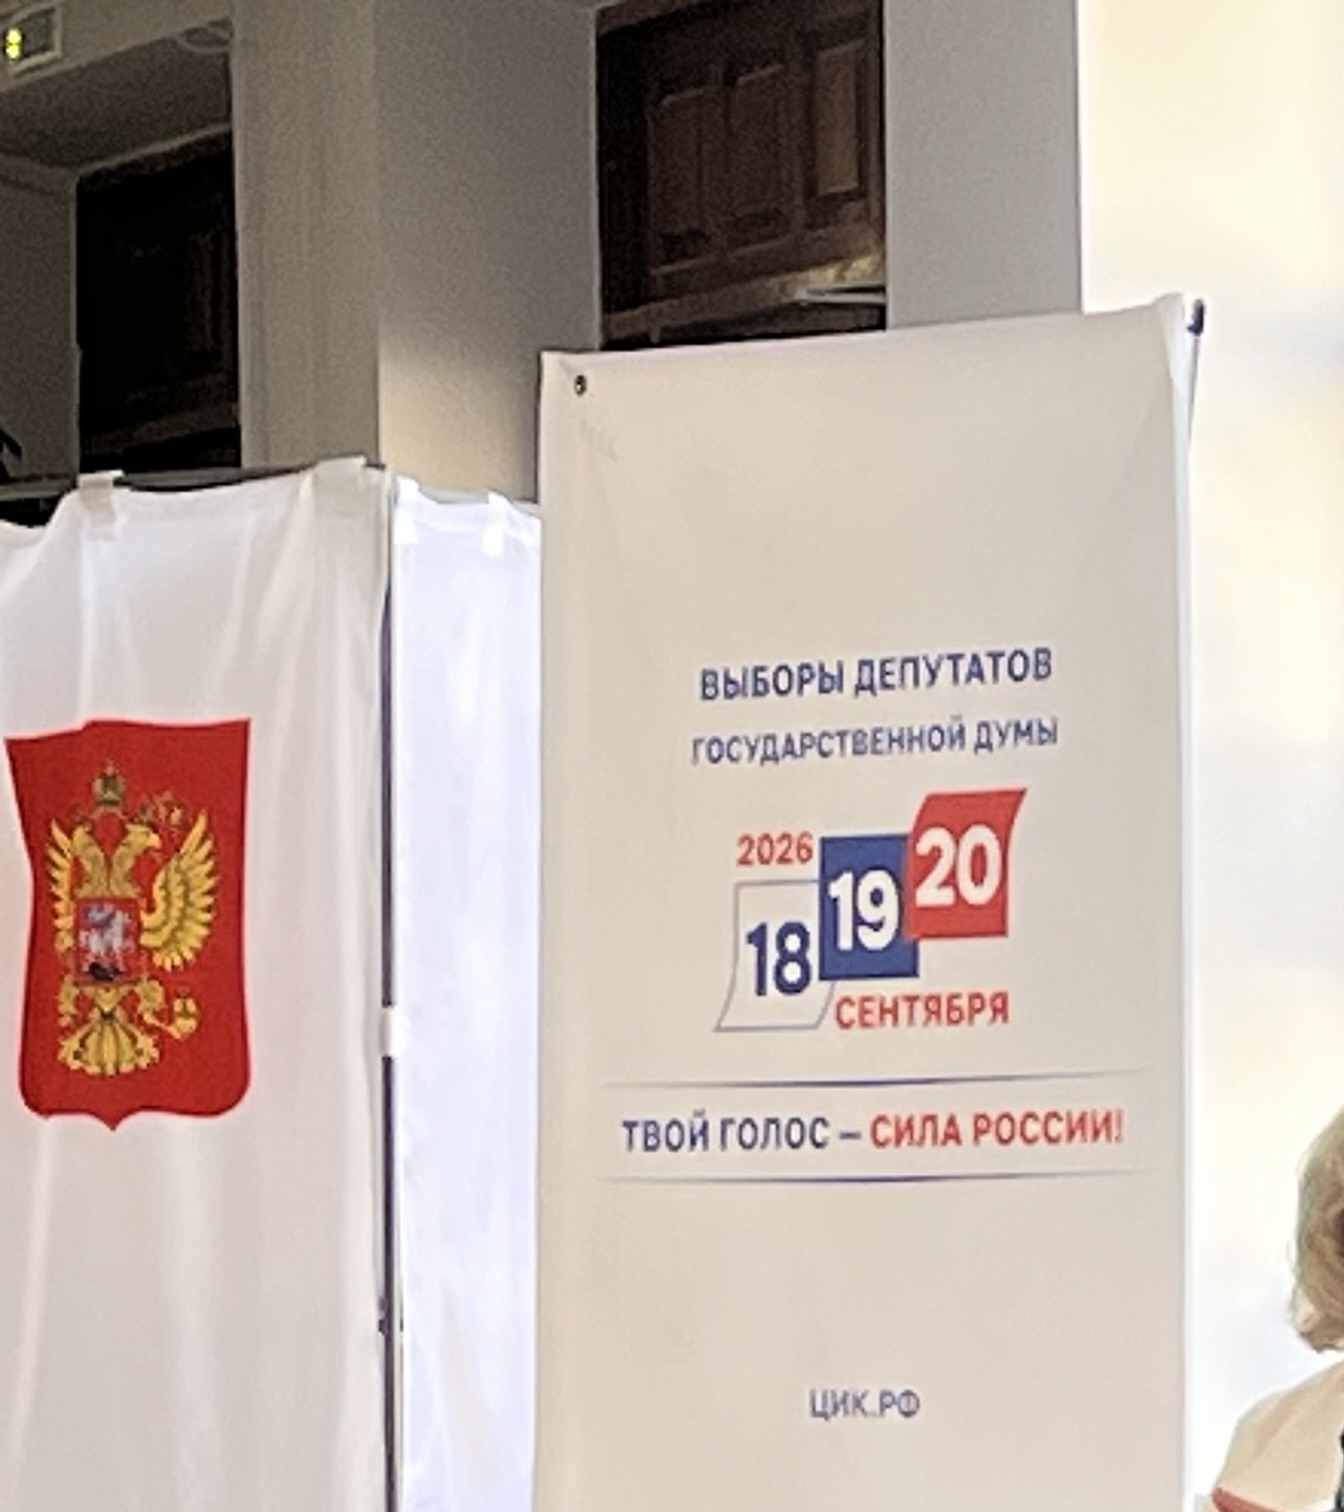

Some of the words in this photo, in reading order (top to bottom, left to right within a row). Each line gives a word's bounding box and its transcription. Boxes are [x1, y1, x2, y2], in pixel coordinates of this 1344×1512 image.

[700, 660, 844, 702] ВЫБОРЫ
[854, 646, 1053, 698] ДЕПУТАТОВ
[691, 716, 966, 767] ГОСУДАРСТВЕННОЙ
[973, 717, 1059, 755] ДУМЫ
[737, 831, 814, 867] 2026
[915, 823, 1002, 908] 20
[828, 869, 900, 952] 19
[746, 921, 812, 997] 18
[834, 991, 1010, 1030] СЕНТЯБРЯ
[622, 1110, 710, 1153] ТВОЙ
[720, 1117, 830, 1152] ГОЛОС
[869, 1113, 963, 1149] СИЛА
[972, 1110, 1124, 1148] РОССИИ!
[809, 1389, 921, 1422] ЦИК.РФ
